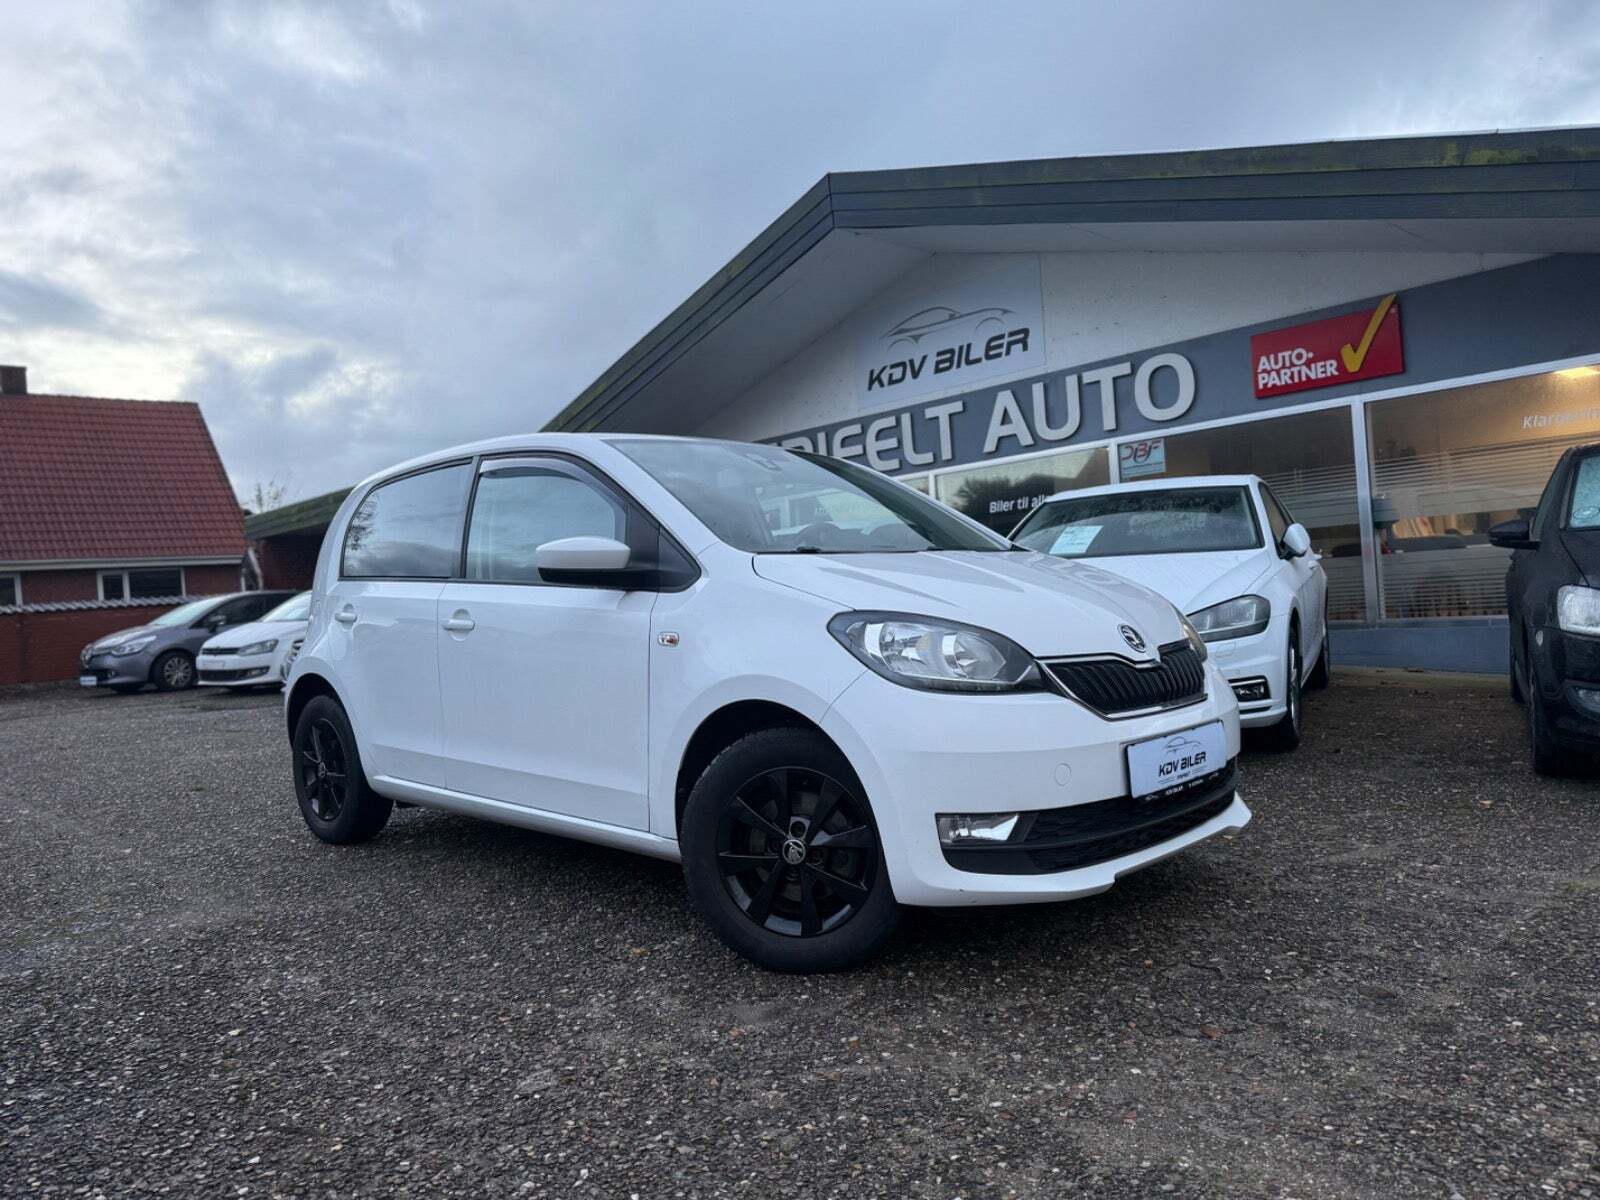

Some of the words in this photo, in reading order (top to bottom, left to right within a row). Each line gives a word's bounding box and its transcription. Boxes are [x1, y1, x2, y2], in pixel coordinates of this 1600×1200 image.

[867, 354, 928, 391] KDV
[933, 327, 1030, 375] BILER
[1257, 359, 1339, 390] PARTNER
[982, 352, 1197, 454] AUTO
[989, 500, 1015, 513] Biler
[1016, 496, 1029, 510] til
[1158, 761, 1178, 777] KDV
[1181, 752, 1205, 770] BILER
